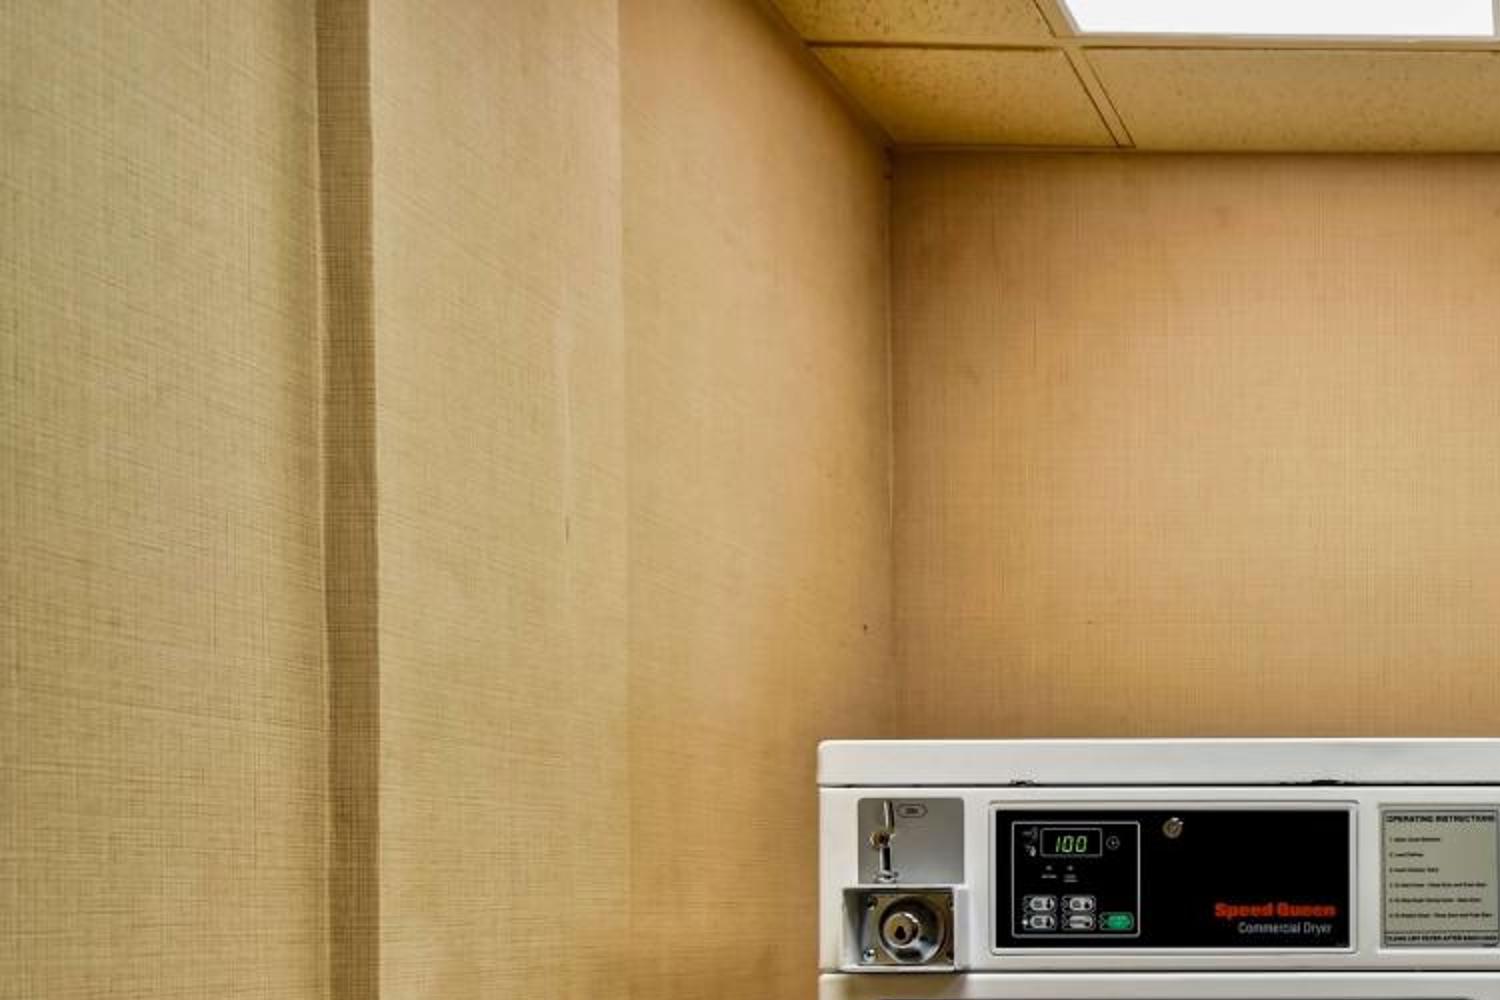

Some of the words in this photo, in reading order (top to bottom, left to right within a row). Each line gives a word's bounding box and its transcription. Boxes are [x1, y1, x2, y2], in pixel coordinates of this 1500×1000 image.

[1386, 815, 1433, 823] OPERATING
[1056, 835, 1087, 853] 100
[1215, 901, 1273, 920] Speed
[1277, 901, 1336, 917] Queen
[1238, 921, 1301, 934] Commercial
[1303, 921, 1332, 936] Dryer
